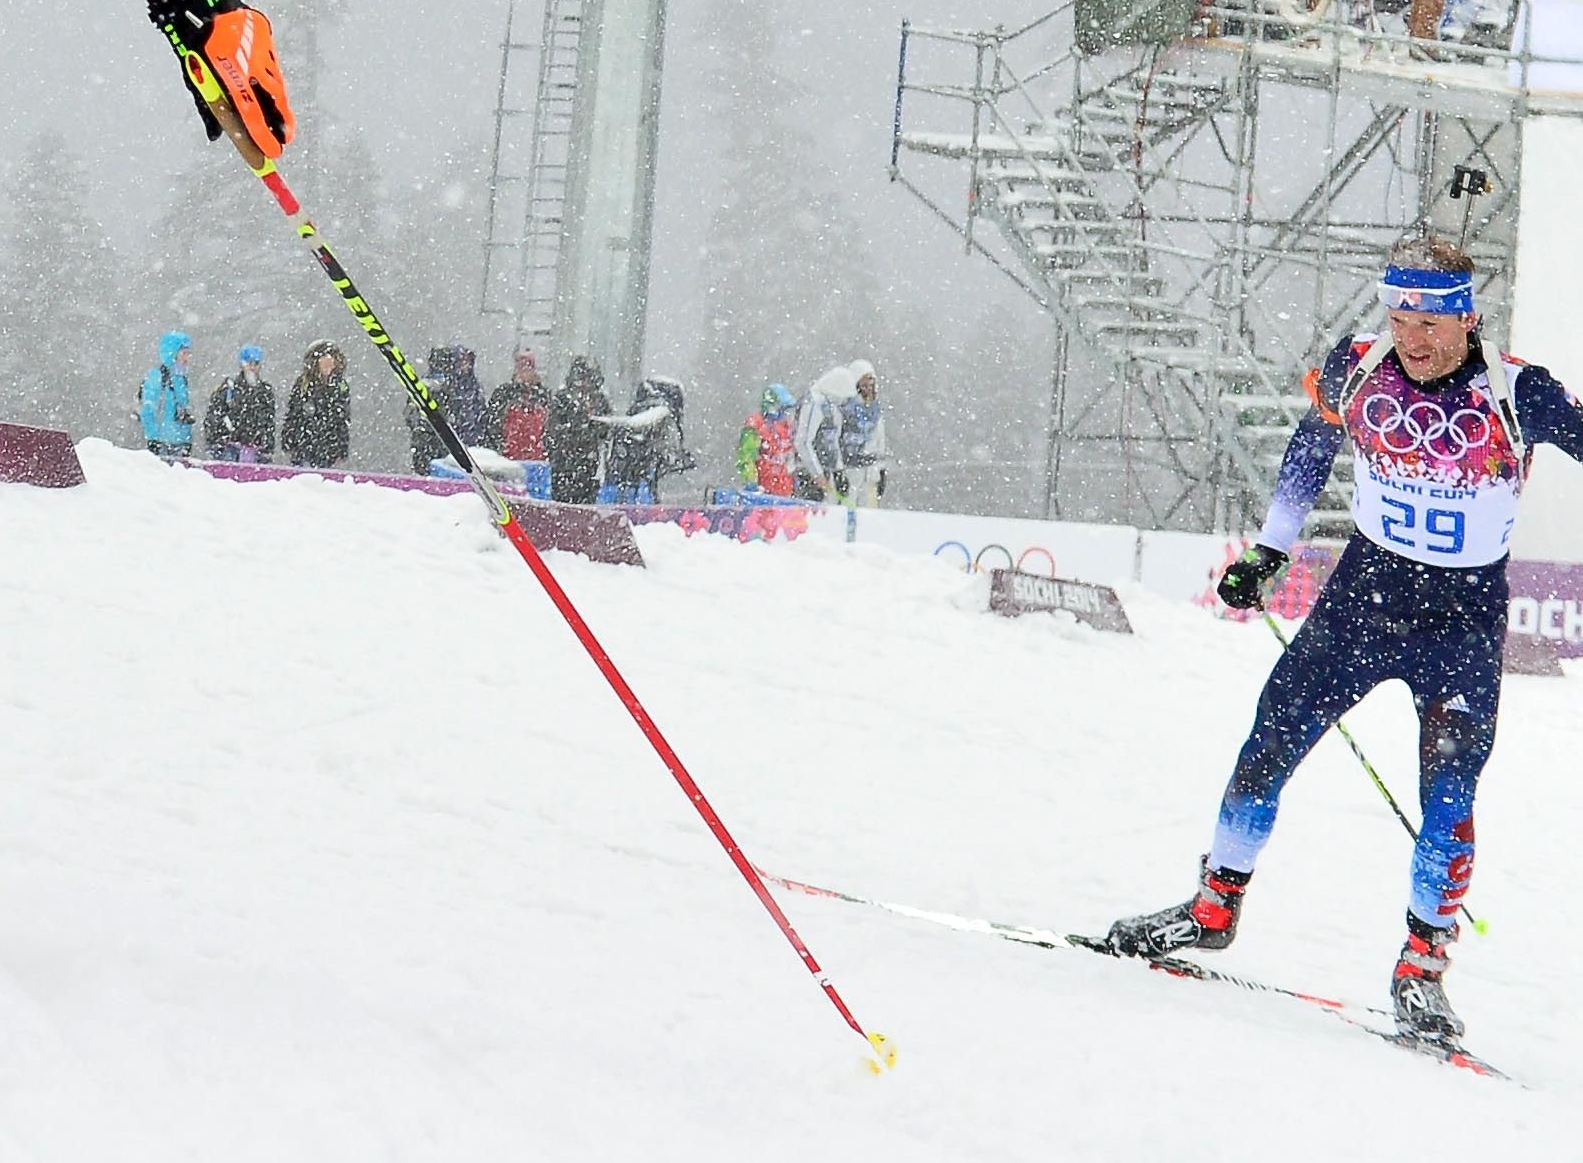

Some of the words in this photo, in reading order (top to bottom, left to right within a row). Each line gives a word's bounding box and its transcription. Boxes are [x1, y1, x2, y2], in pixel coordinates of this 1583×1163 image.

[332, 276, 390, 345] LEKI
[1381, 494, 1465, 554] 29
[1507, 595, 1583, 643] OCH
